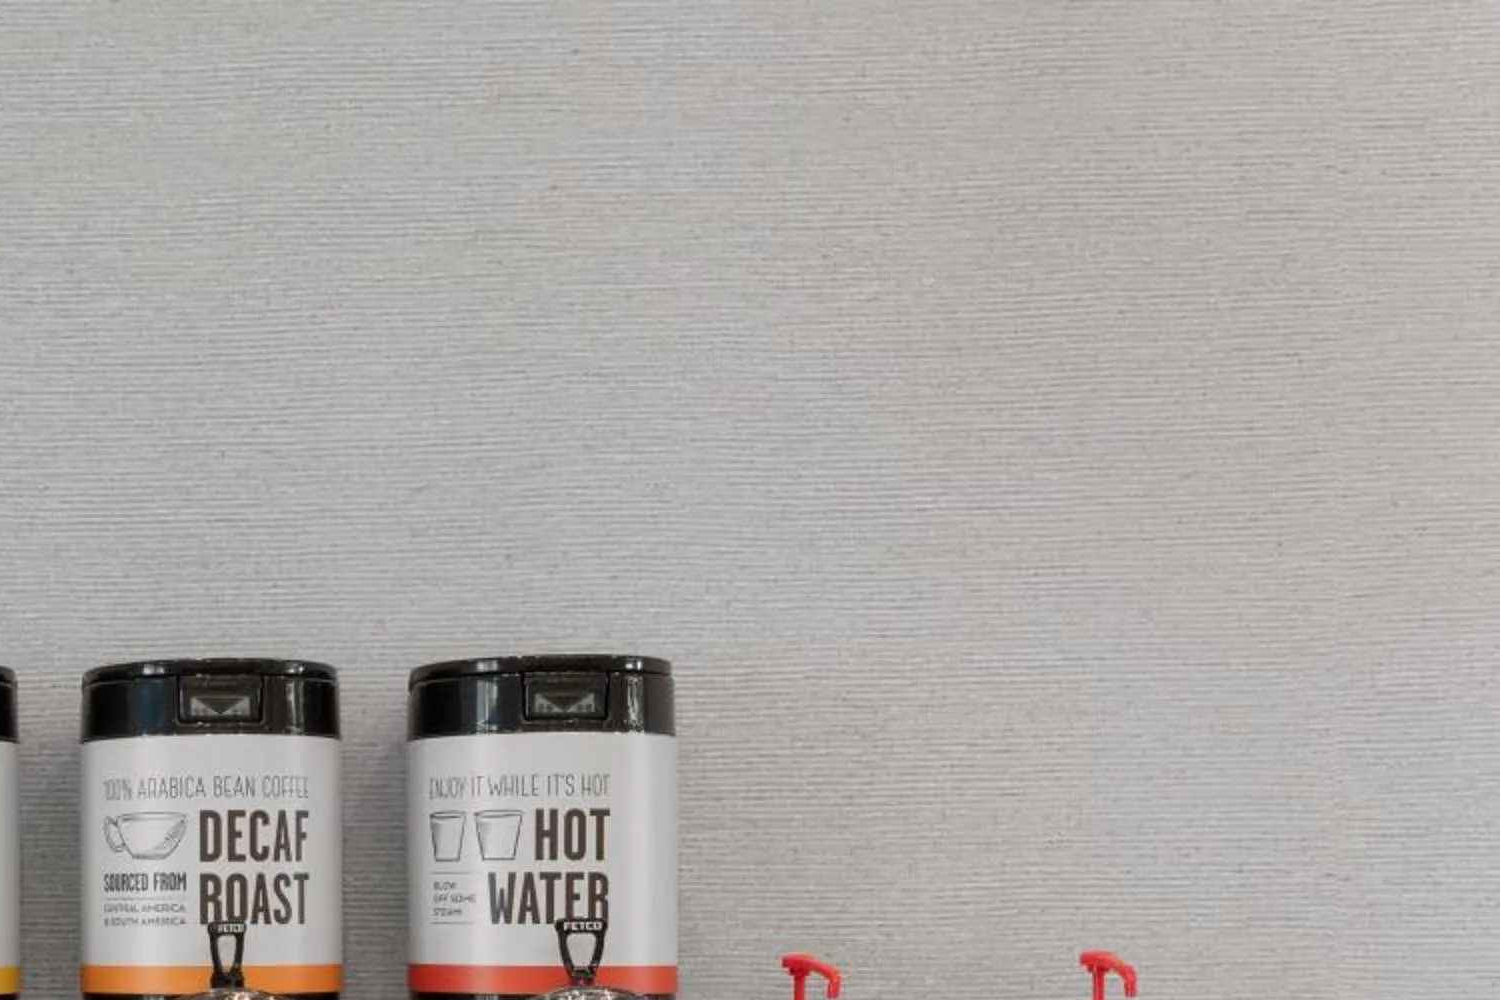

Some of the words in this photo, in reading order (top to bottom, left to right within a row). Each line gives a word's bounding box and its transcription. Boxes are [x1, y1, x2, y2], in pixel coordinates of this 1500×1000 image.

[138, 775, 206, 799] ARABICA
[213, 775, 256, 798] BEAN
[262, 774, 309, 799] COFFEE
[471, 775, 484, 798] IT
[488, 774, 539, 798] WHILE
[547, 773, 575, 797] IT'S
[581, 773, 611, 797] HOT
[199, 809, 309, 862] DECAF
[535, 808, 610, 861] HOT
[103, 872, 149, 892] SOURCED
[153, 872, 187, 891] FROM
[199, 873, 310, 925] ROAST
[488, 871, 609, 925] WATER
